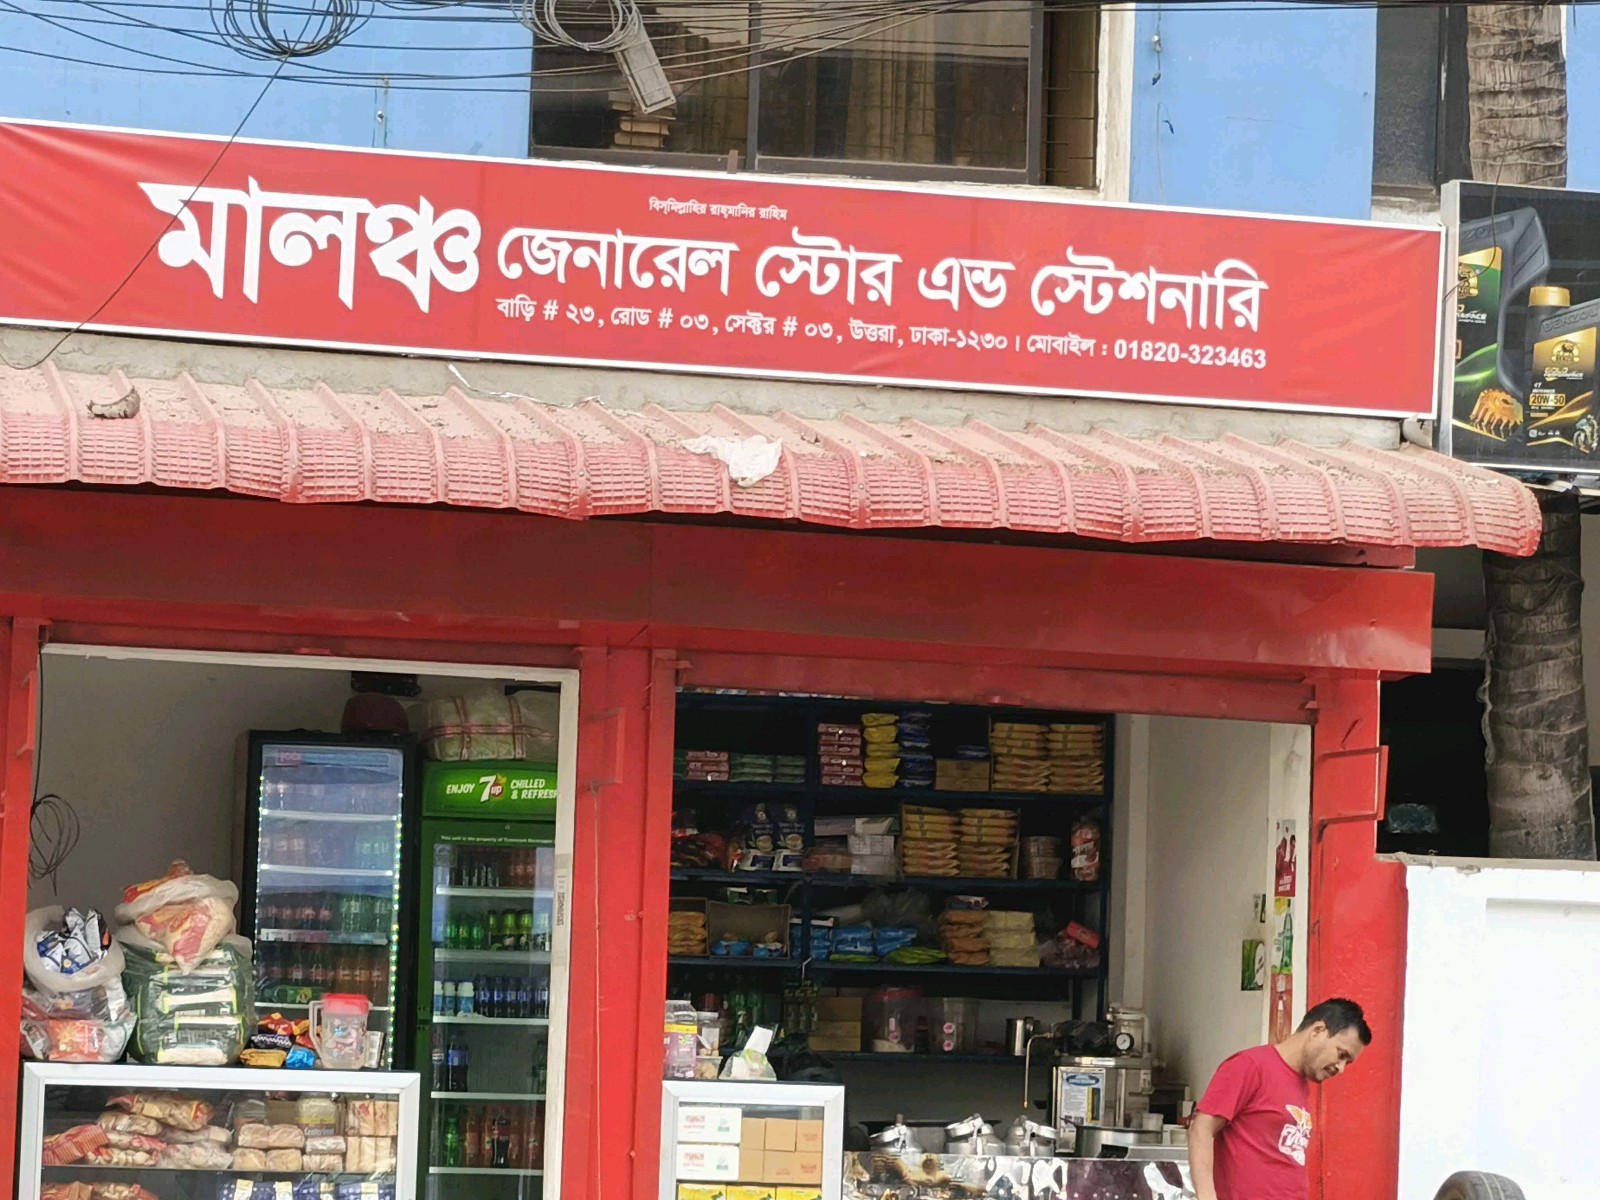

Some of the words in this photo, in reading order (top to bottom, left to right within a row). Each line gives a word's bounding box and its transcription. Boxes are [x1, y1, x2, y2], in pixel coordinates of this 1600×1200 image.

[758, 204, 788, 221] রাহিম
[137, 175, 481, 314] মালঞ্চ
[496, 226, 740, 296] জেনারেল
[755, 225, 903, 307] স্টোর
[917, 256, 1016, 312] এন্ড
[1030, 245, 1269, 333] স্টেশনারি
[496, 293, 537, 322] বাড়ি
[543, 299, 559, 321] #
[610, 306, 653, 327] রোড
[657, 307, 674, 329] #
[724, 309, 777, 336] সেক্টর
[783, 315, 799, 337] #
[1026, 331, 1096, 357] মোবাইল
[1114, 338, 1267, 370] 01820-323463
[1531, 394, 1565, 406] 20W-50
[446, 783, 476, 795] ENJOY
[510, 778, 546, 790] CHILLED
[510, 789, 519, 800] &
